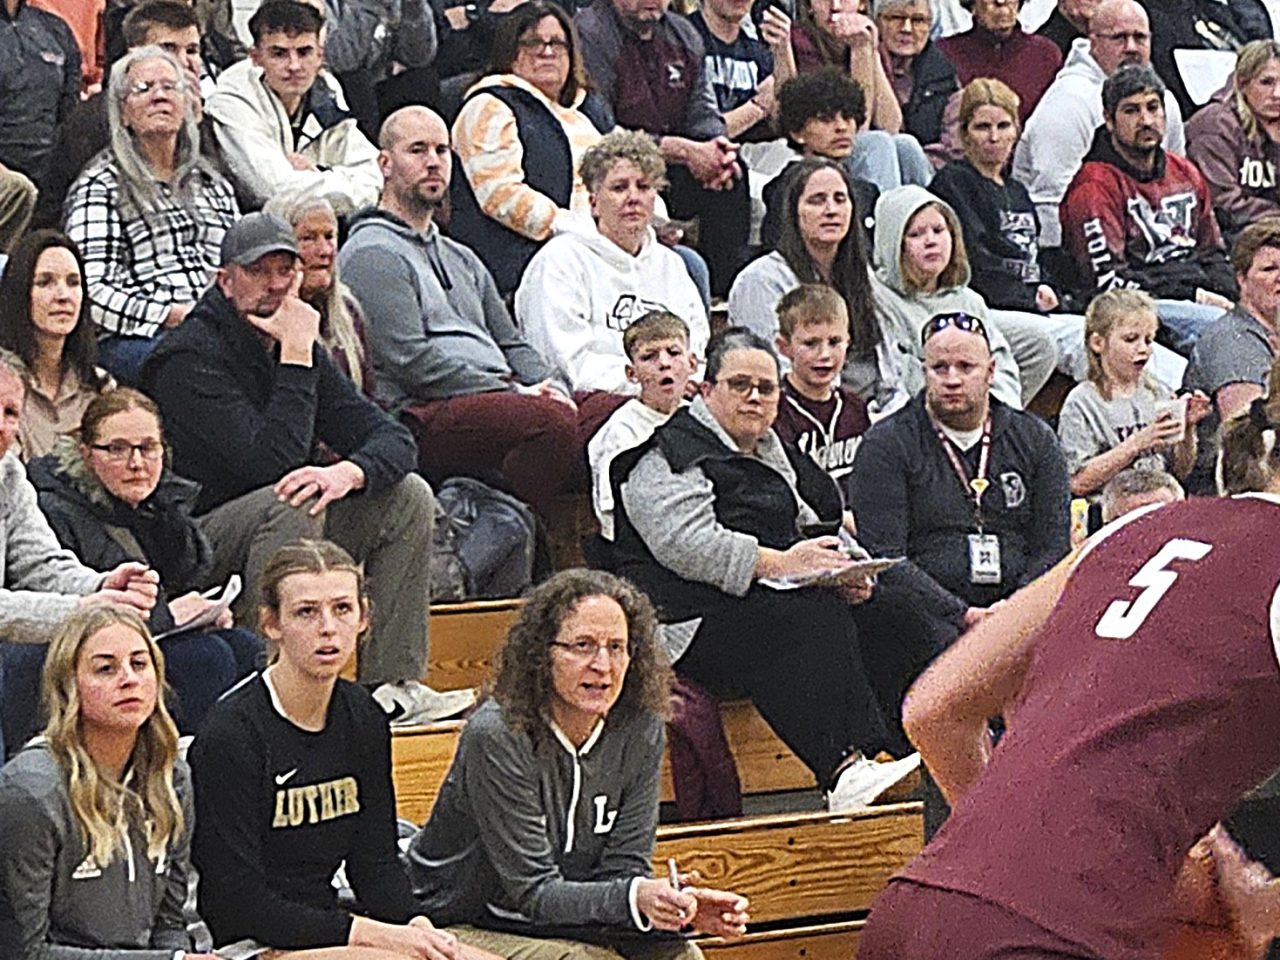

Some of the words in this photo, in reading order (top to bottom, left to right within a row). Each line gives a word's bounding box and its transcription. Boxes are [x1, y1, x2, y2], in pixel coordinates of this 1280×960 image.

[1094, 537, 1214, 641] 5
[272, 776, 360, 829] LUTHER
[593, 795, 618, 834] L
